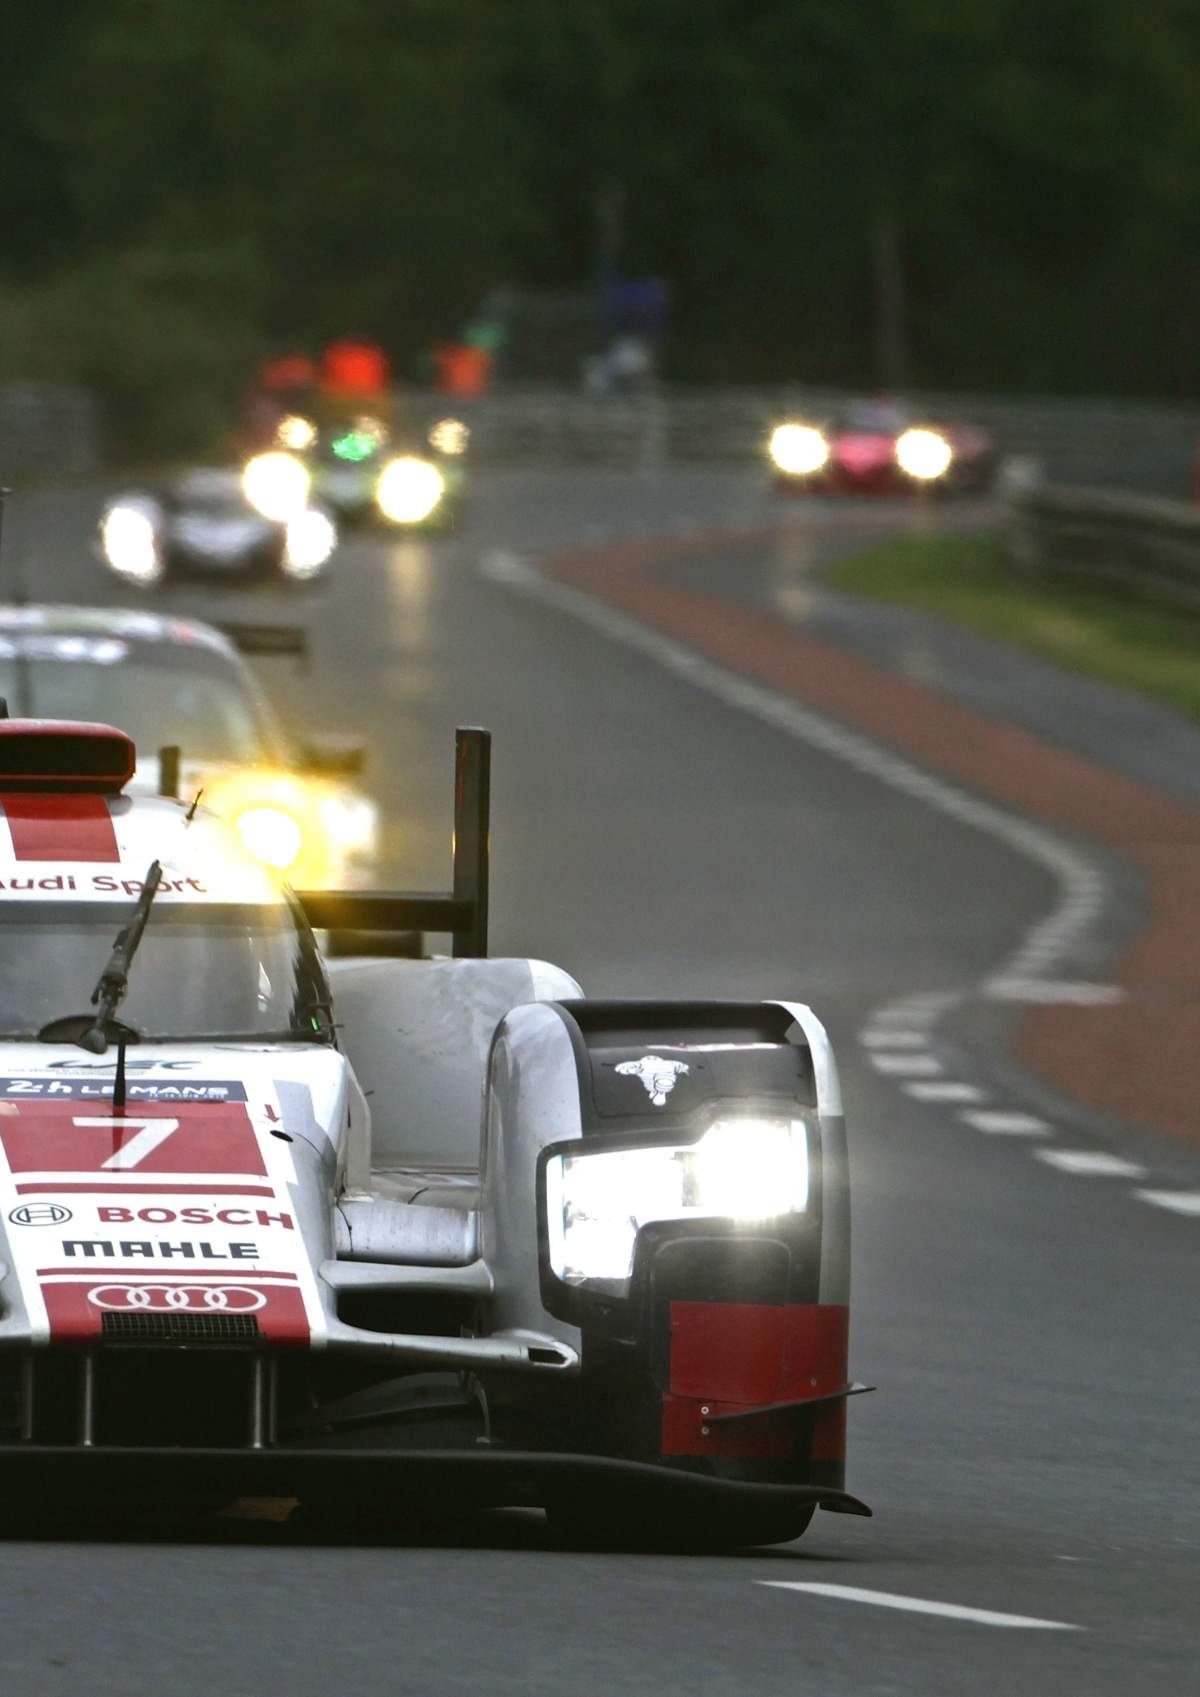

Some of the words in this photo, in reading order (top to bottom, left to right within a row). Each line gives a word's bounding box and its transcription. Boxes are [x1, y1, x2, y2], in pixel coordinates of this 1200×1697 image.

[91, 875, 207, 896] Sport
[129, 1085, 230, 1096] MANS
[71, 1116, 180, 1169] 7
[96, 1206, 295, 1231] BOSCH
[61, 1239, 261, 1260] MAHLE
